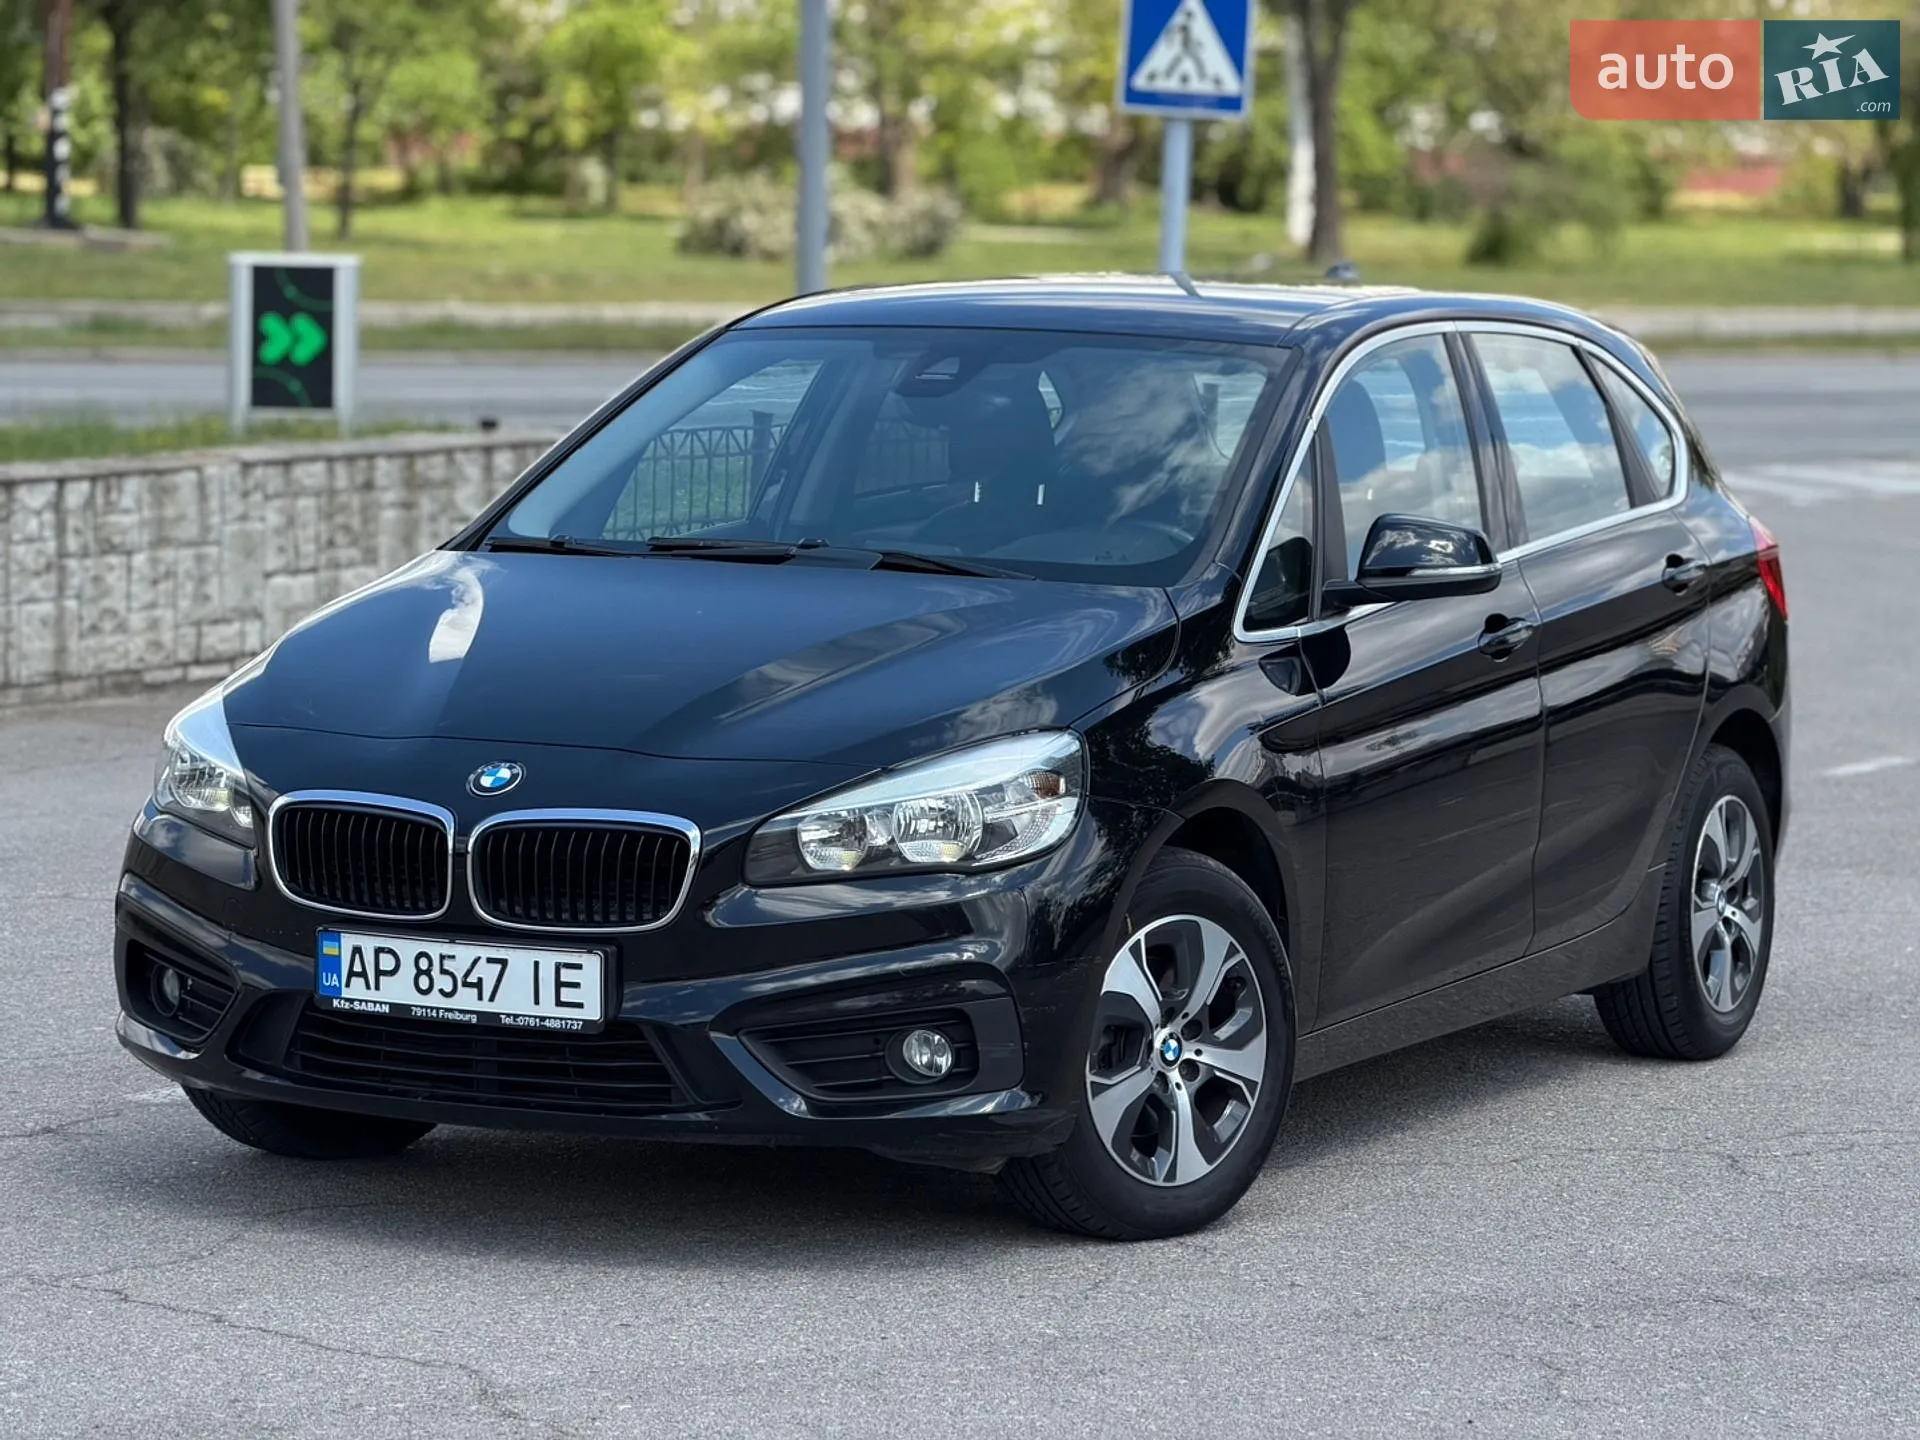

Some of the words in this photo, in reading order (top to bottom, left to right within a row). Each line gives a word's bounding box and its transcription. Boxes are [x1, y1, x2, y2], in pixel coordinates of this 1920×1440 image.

[322, 971, 340, 988] UA
[344, 944, 401, 991] AP
[413, 951, 509, 1003] 8547
[533, 959, 585, 1009] IE
[332, 998, 390, 1014] Kfz-SABAN
[410, 1006, 437, 1018] 79114
[438, 1009, 478, 1024] Freiburg
